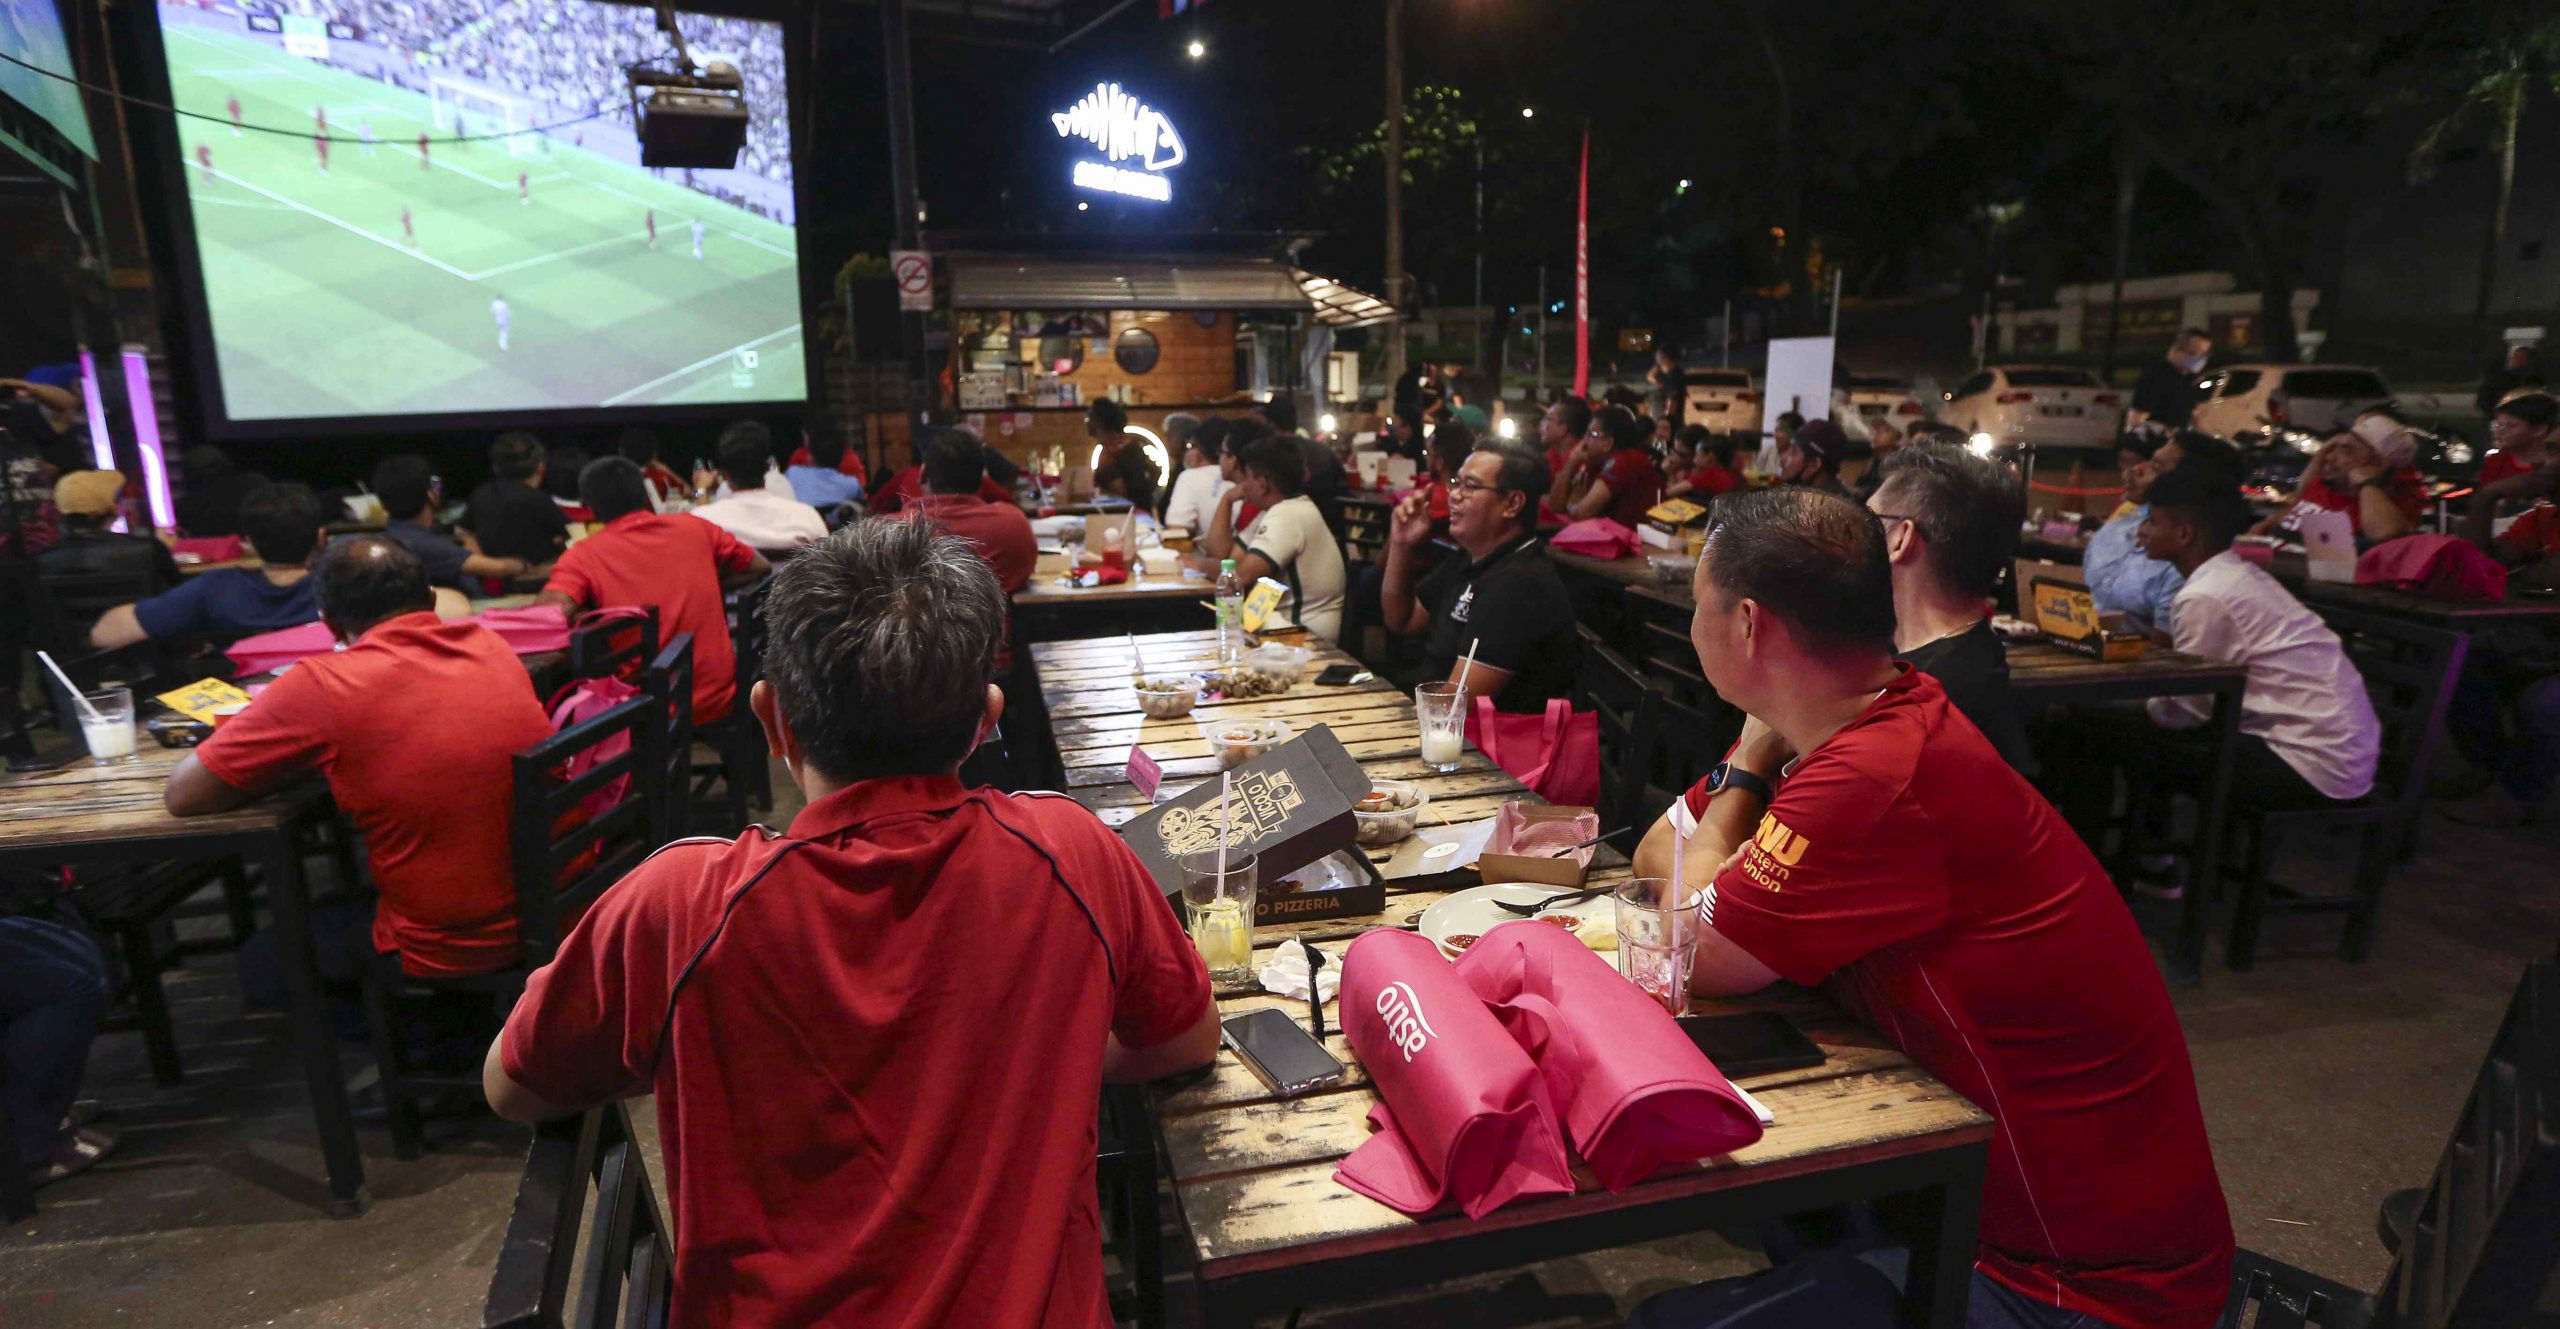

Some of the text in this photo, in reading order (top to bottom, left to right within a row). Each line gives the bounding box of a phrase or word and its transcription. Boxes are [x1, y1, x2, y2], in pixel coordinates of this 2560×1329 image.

[1248, 784, 1278, 821] VICOLO
[1743, 857, 1781, 893] Union
[1749, 843, 1790, 880] estern
[1274, 896, 1340, 914] PIZZERIA
[1376, 985, 1428, 1063] astro
